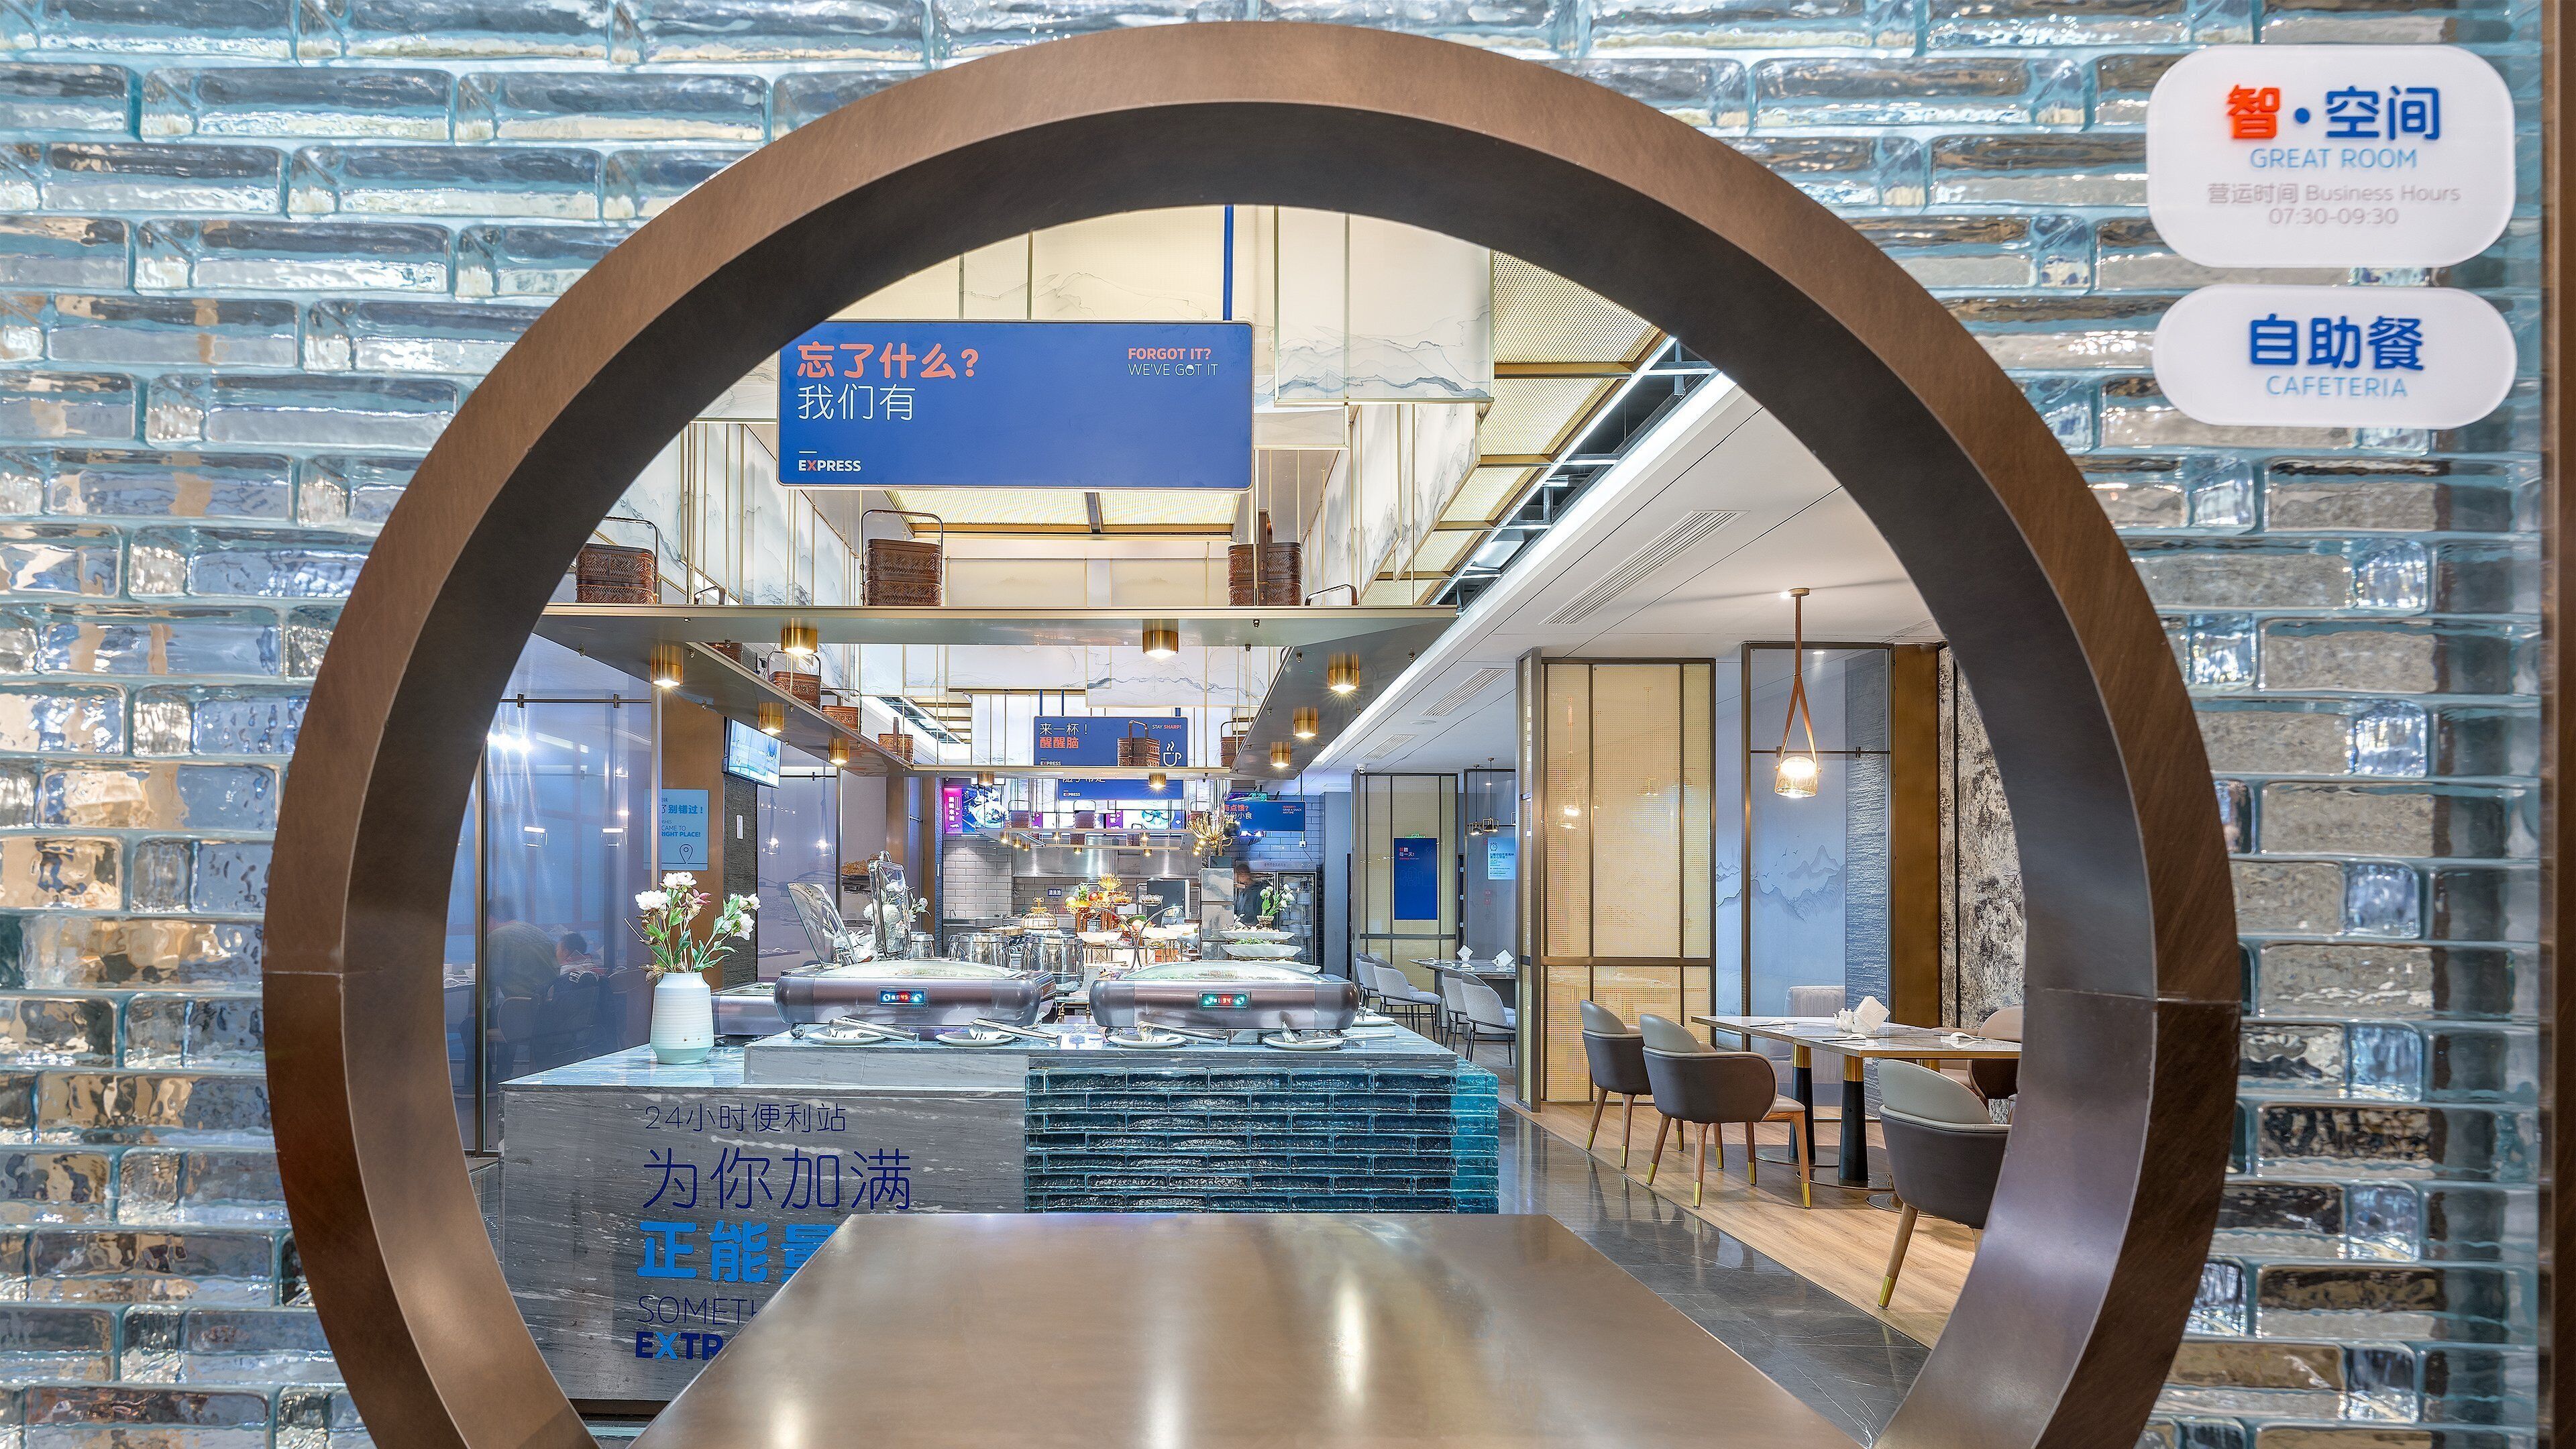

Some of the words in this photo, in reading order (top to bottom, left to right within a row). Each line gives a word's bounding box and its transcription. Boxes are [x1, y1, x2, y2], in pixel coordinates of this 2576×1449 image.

[2250, 148, 2331, 169] GREAT
[2341, 148, 2418, 169] ROOM
[2208, 182, 2299, 204] 营运时间
[2306, 184, 2394, 202] Business
[2400, 185, 2461, 202] Hours
[2268, 207, 2399, 225] 07:30-09:30
[2249, 313, 2424, 372] 自助餐
[797, 341, 979, 380] 忘了什么?
[1128, 347, 1186, 360] FORGOT
[1189, 348, 1212, 360] IT?
[1128, 364, 1170, 376] WE'VE
[1175, 364, 1202, 376] GOT
[1207, 364, 1218, 376] IT
[2266, 375, 2409, 398] CAFETERIA
[797, 383, 916, 421] 我们有
[798, 460, 862, 472] EXPRESS
[1039, 722, 1088, 735] 来一杯！
[1040, 737, 1079, 749] 醒醒脑
[661, 804, 703, 814] 了别错过！
[645, 1103, 847, 1132] 24小时便利站
[642, 1147, 912, 1210] 为你加满
